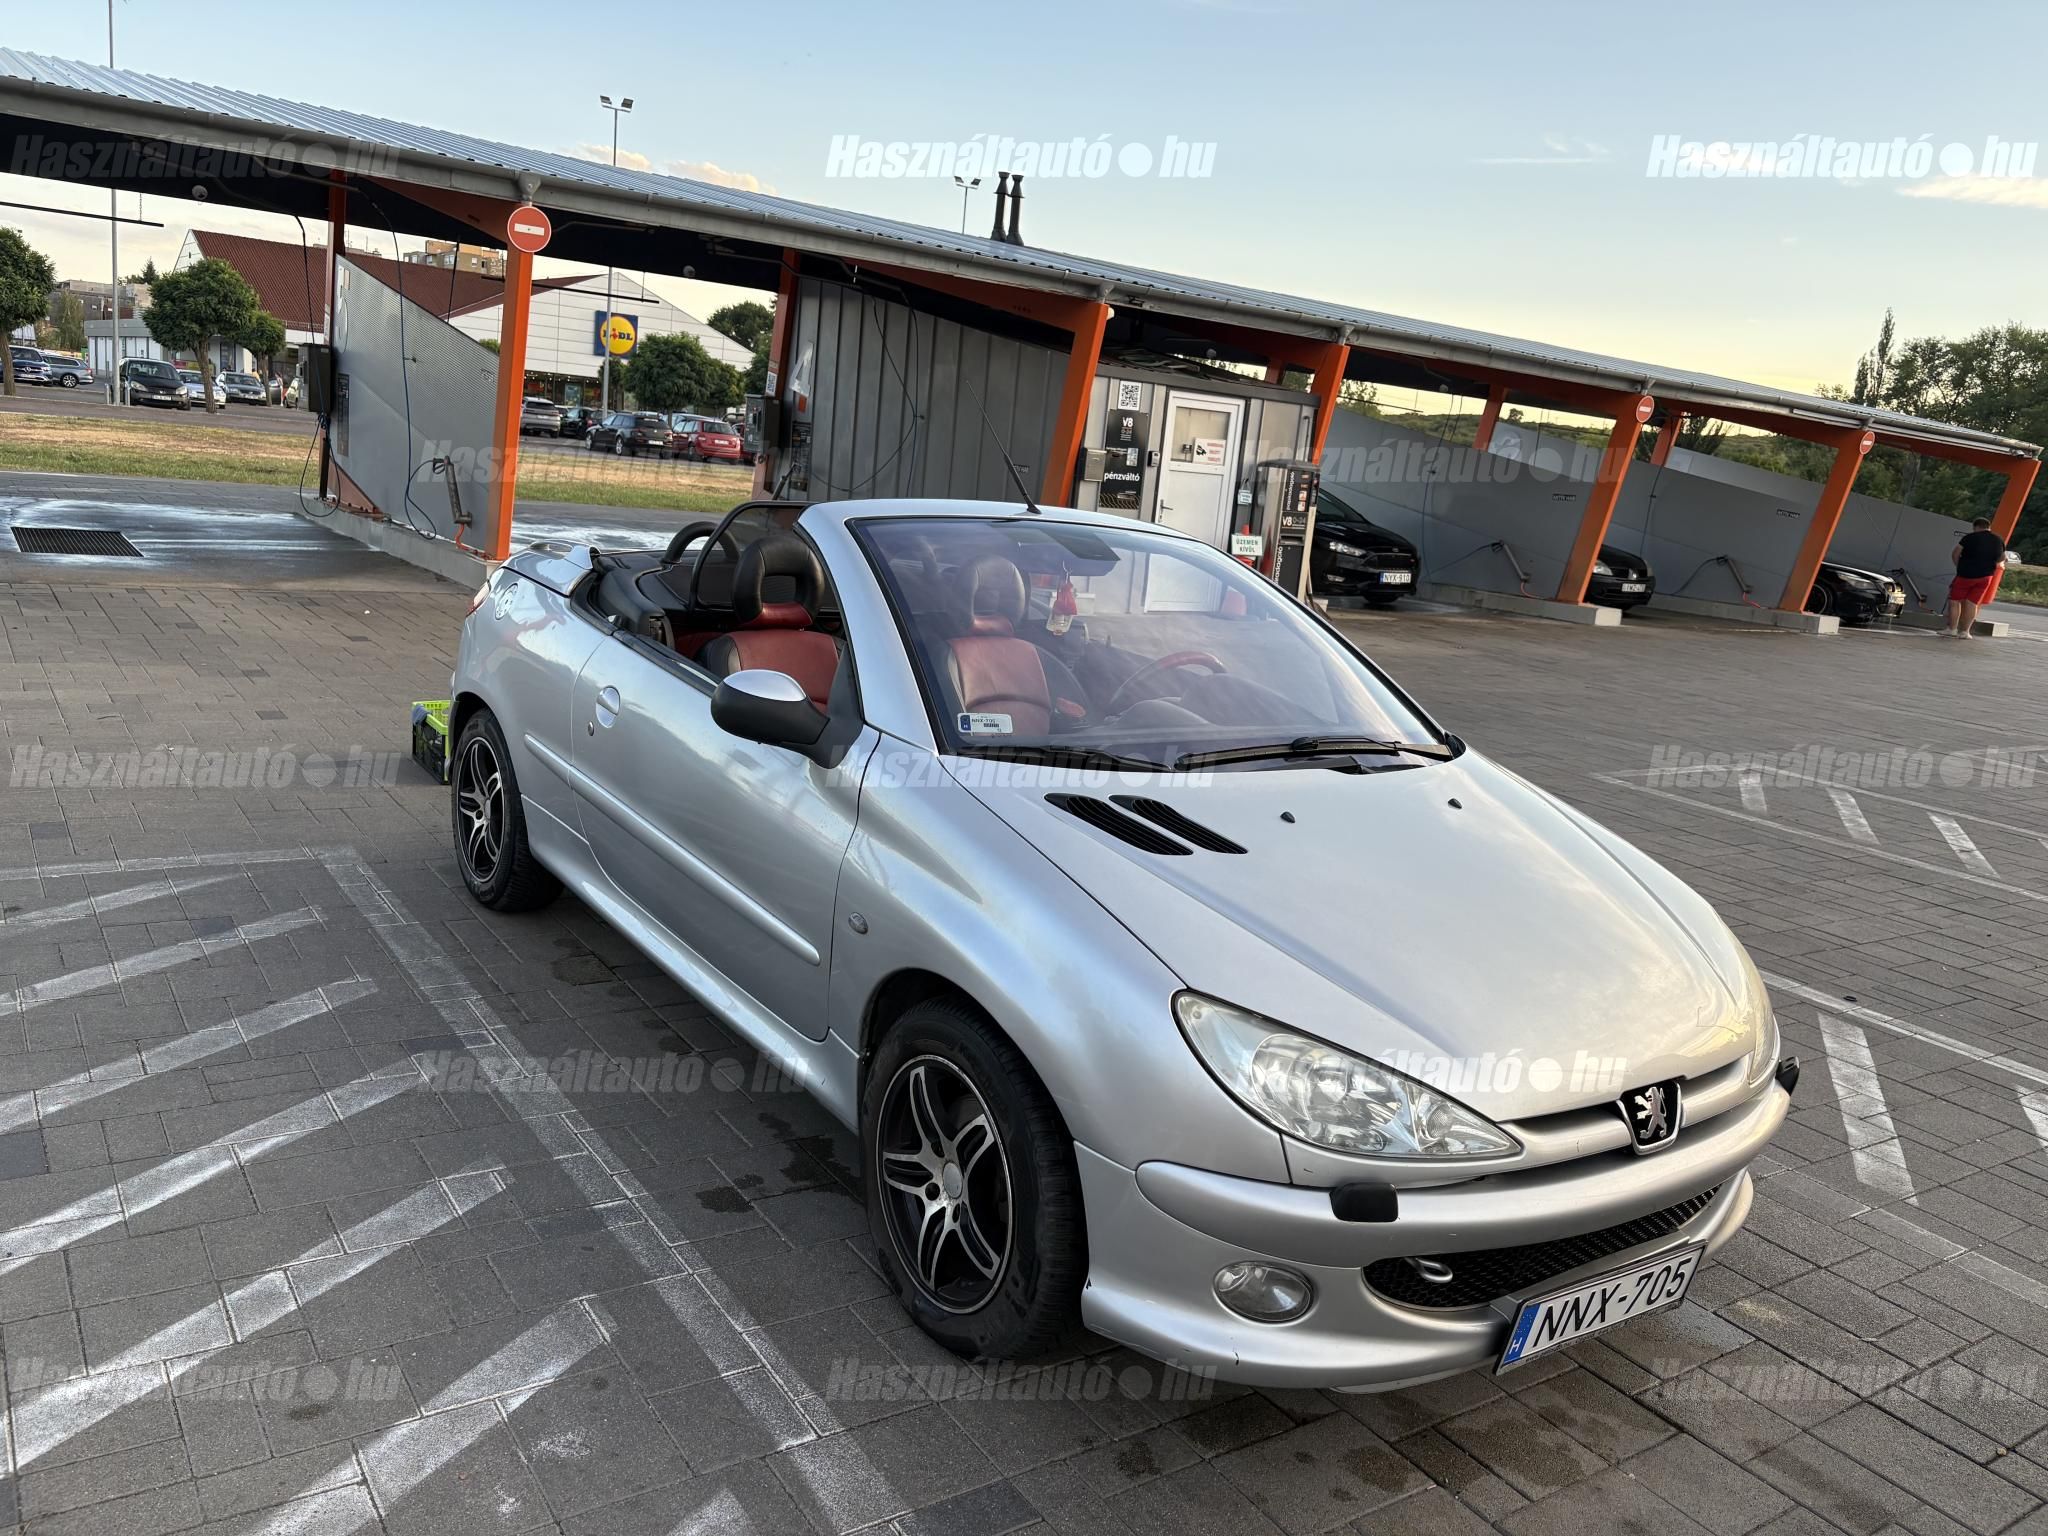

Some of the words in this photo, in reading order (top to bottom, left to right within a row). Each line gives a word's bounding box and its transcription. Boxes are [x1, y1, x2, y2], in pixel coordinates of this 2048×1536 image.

[1122, 416, 1133, 427] V8
[1104, 471, 1140, 481] pénzváltó
[1283, 516, 1292, 526] V8
[1508, 1337, 1523, 1355] H
[1532, 1256, 1693, 1348] NNX-705
